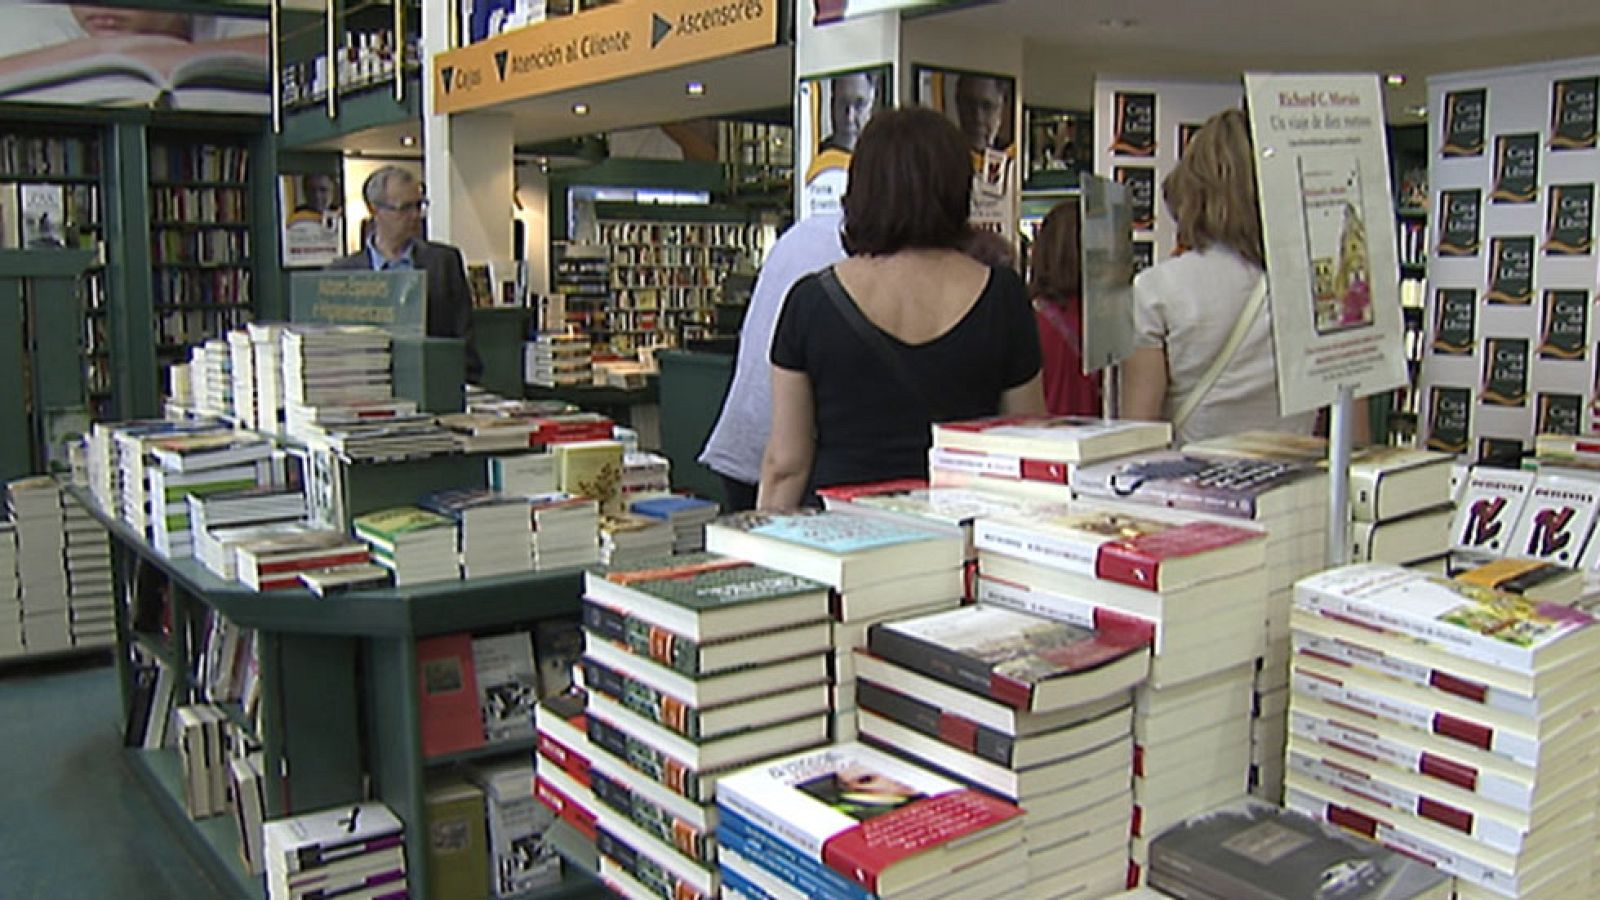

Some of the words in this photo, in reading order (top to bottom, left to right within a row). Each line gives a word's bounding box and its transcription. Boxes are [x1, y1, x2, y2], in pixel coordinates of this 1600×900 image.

[675, 0, 764, 36] Ascensores
[512, 44, 563, 73] Atención
[565, 39, 579, 63] al
[581, 30, 631, 60] Cliente
[456, 68, 481, 91] Cajas
